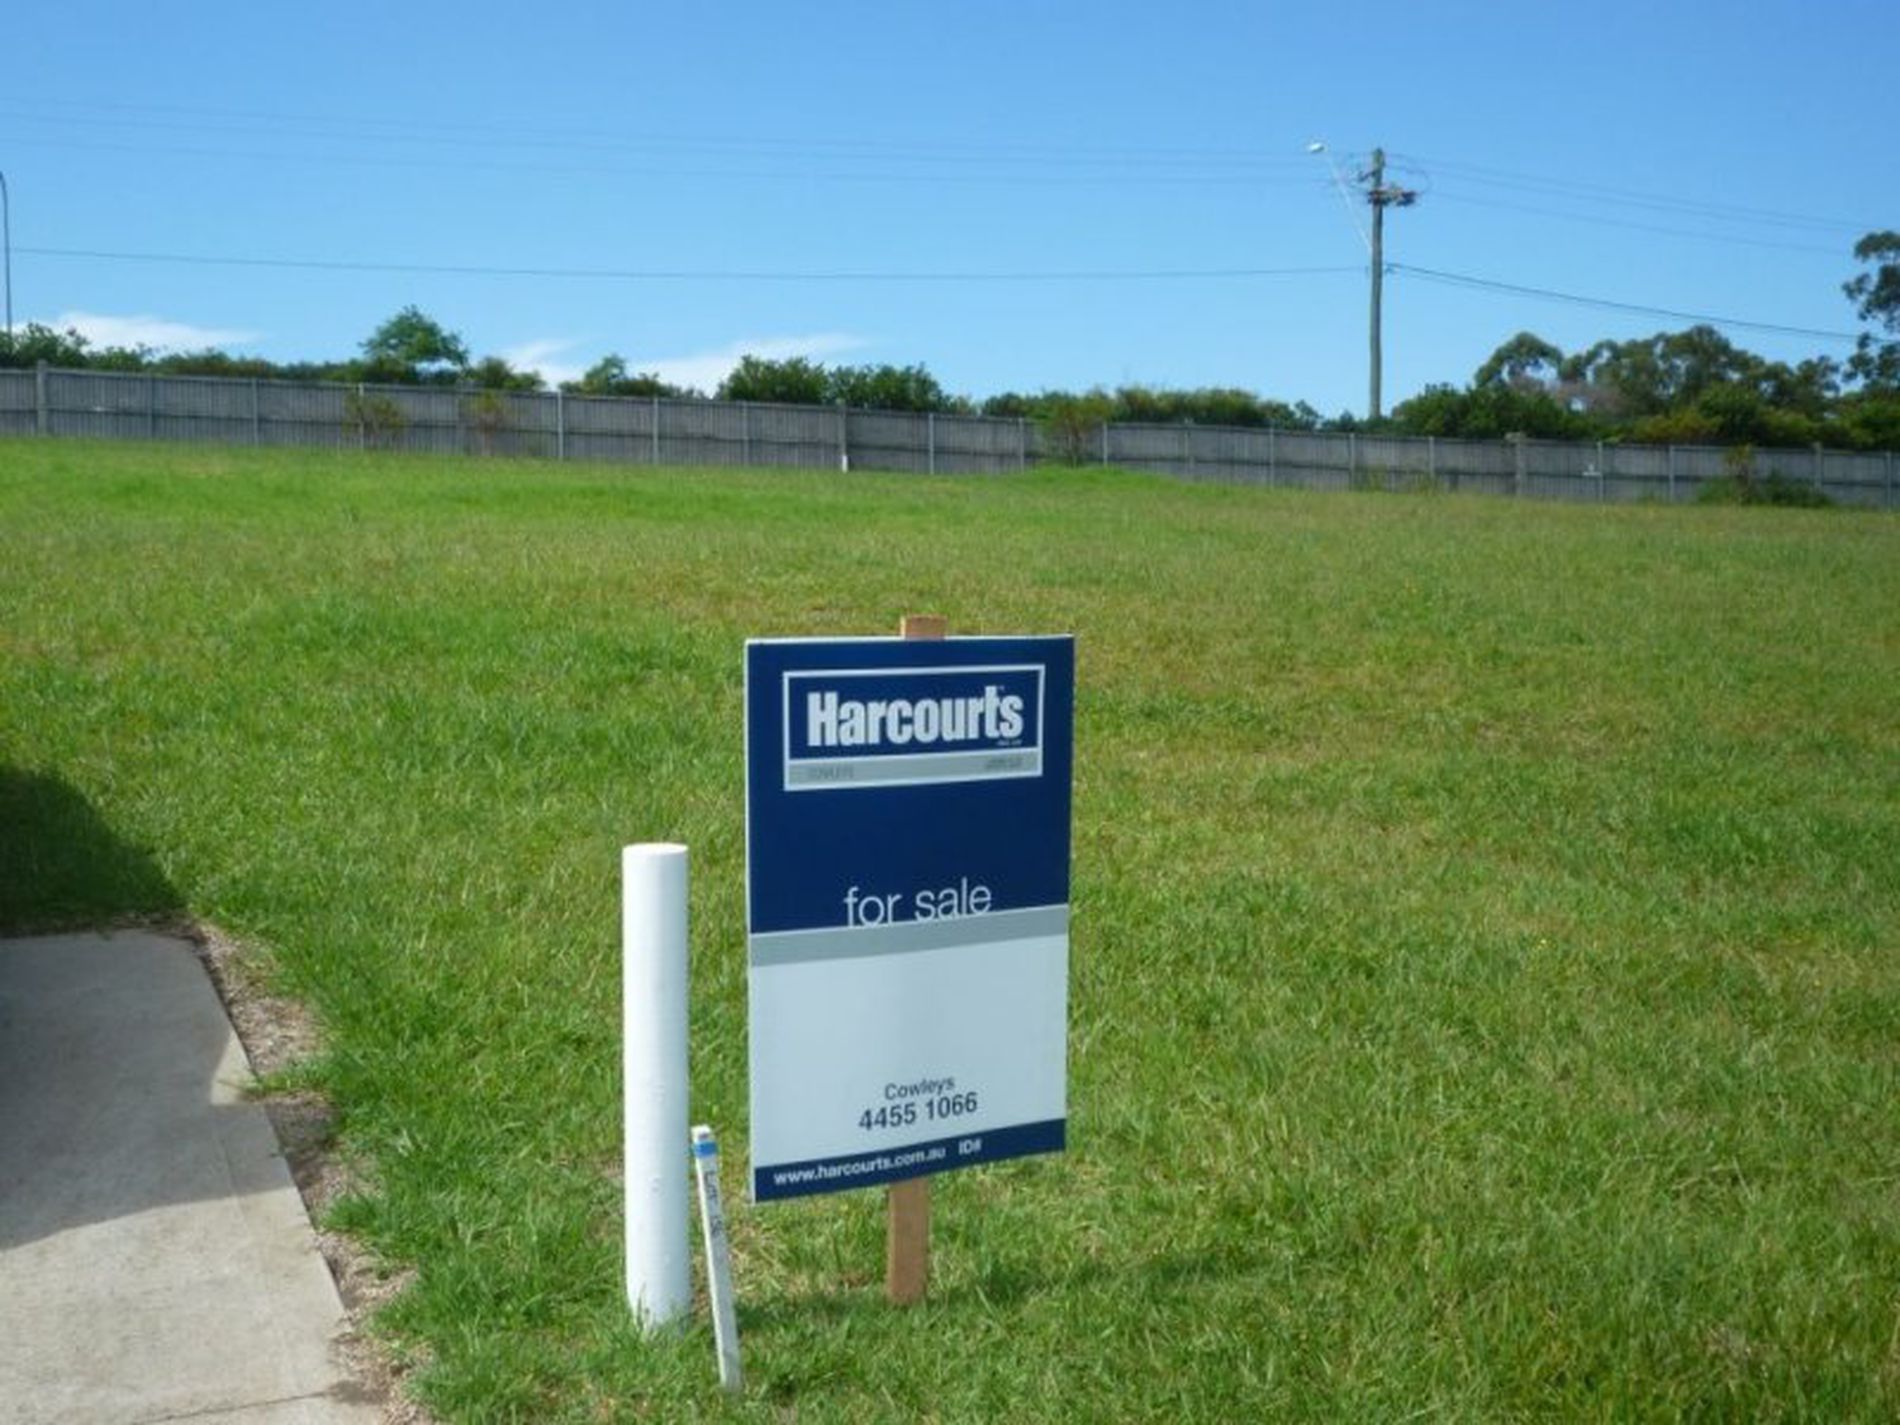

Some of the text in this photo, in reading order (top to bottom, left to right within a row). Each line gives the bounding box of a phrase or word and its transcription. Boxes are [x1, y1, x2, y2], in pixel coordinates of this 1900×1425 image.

[807, 685, 1024, 746] Harcourts
[844, 876, 992, 927] for sale
[885, 1076, 955, 1100] Cowleys
[858, 1092, 978, 1130] 4455 1066
[774, 1146, 946, 1185] www.harcourts.com.au
